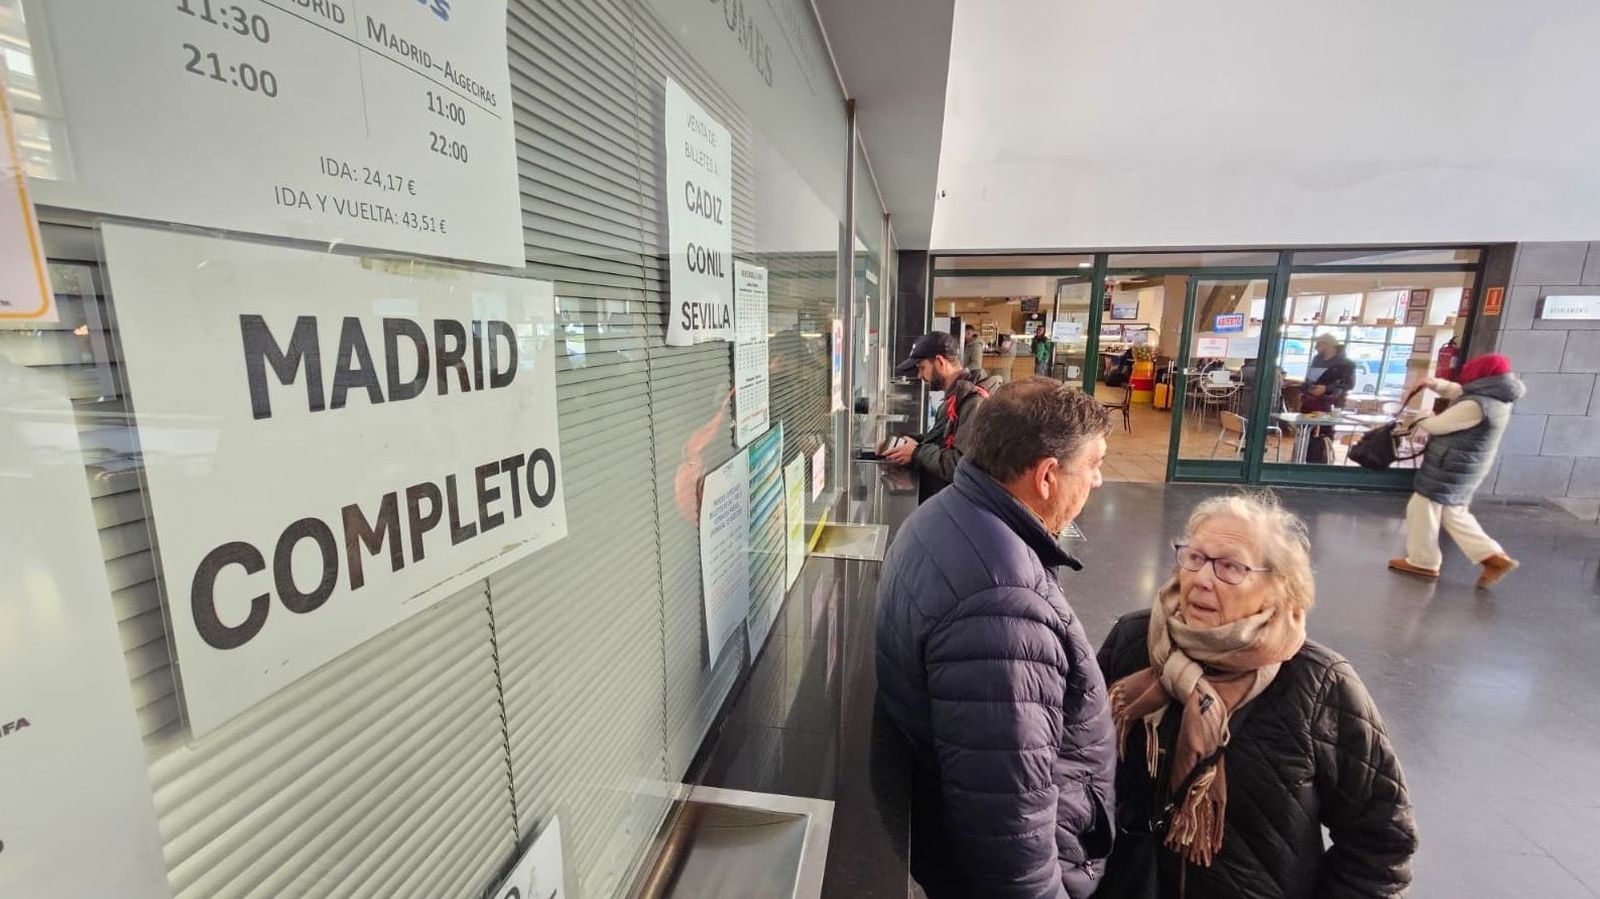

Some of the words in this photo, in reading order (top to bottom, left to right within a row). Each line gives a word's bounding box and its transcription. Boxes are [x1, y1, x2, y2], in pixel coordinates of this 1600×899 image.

[183, 43, 278, 98] 21:00
[426, 91, 466, 126] 11:00
[429, 131, 469, 163] 22:00
[320, 156, 358, 182] IDA:
[362, 167, 403, 192] 24,17
[407, 179, 416, 196] €
[274, 185, 312, 210] IDA
[316, 193, 328, 213] Y
[333, 197, 399, 225] VUELTA:
[402, 211, 436, 233] 43,51
[439, 218, 447, 234] €
[685, 180, 723, 225] CADIZ
[687, 242, 725, 278] CONIL
[681, 301, 731, 331] SEVILLA
[239, 314, 519, 420] MADRID
[191, 448, 556, 651] COMPLETO
